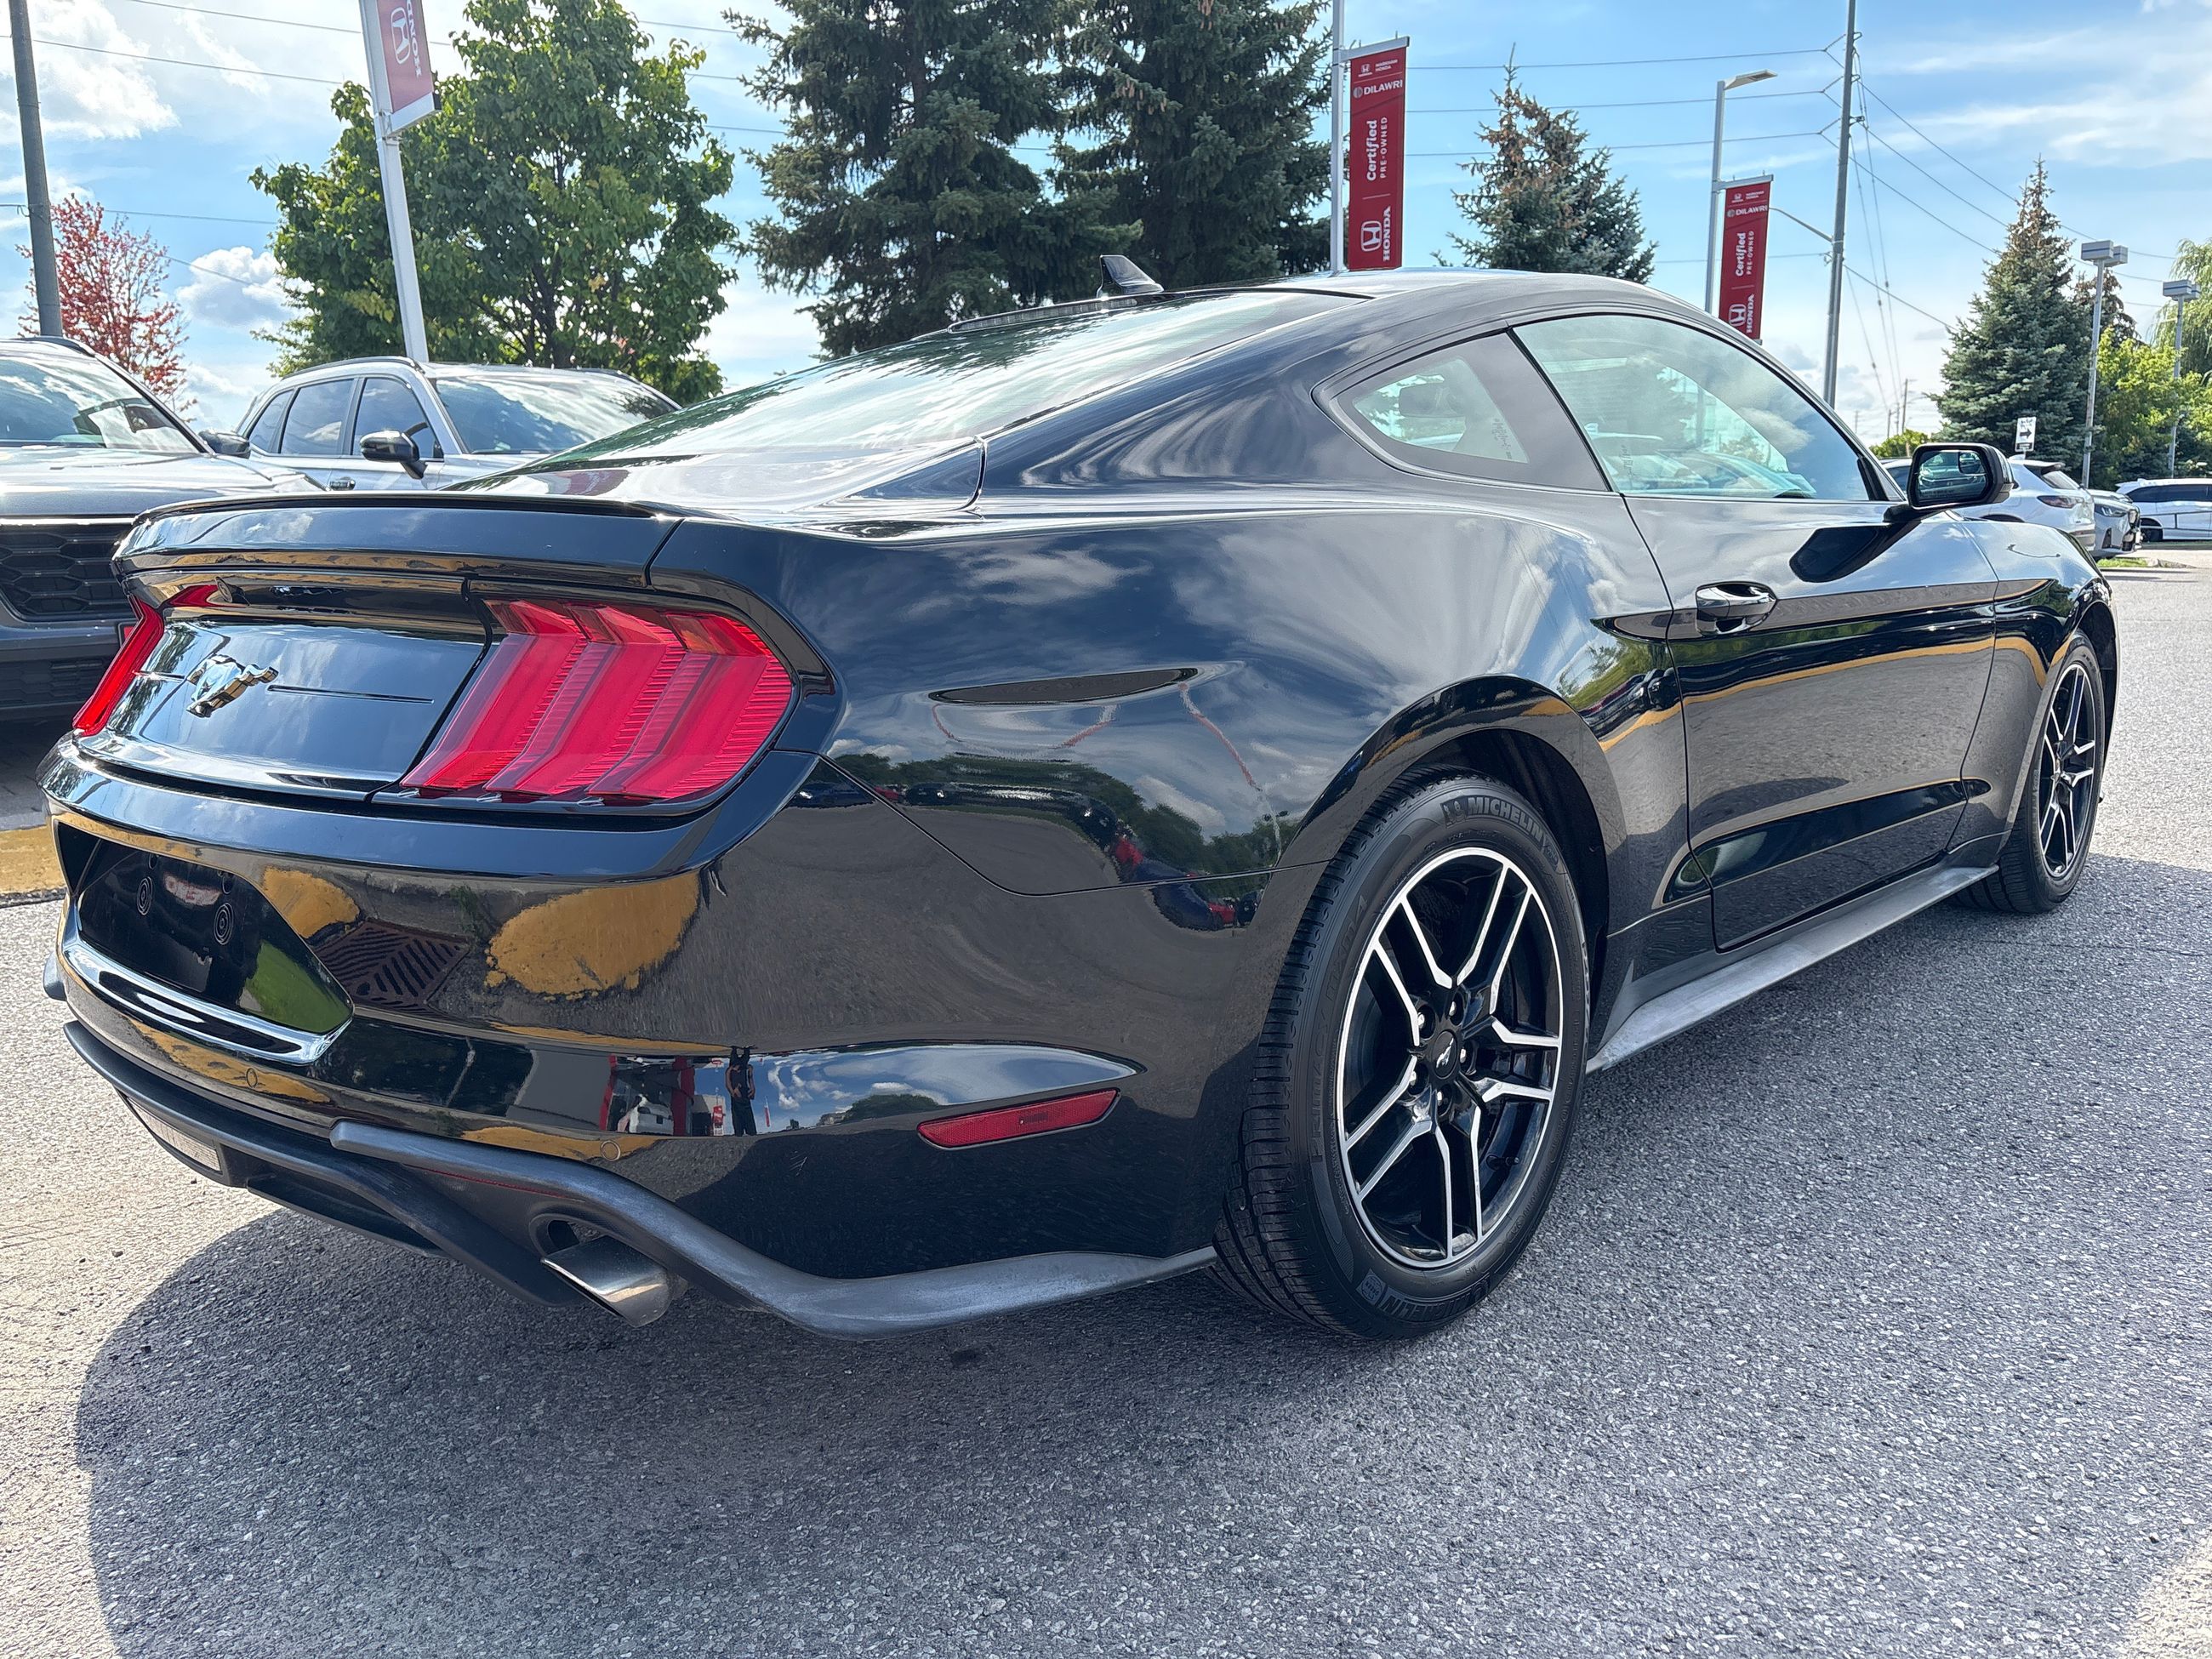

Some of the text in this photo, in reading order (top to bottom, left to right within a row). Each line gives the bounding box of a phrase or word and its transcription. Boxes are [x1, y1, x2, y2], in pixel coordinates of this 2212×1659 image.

[407, 0, 422, 77] HOND
[1363, 79, 1403, 95] DILAWRI
[1366, 120, 1379, 181] Certified
[1382, 206, 1391, 261] HONDA
[1736, 205, 1768, 216] DILAWRI
[1736, 232, 1747, 276] Certified
[1746, 294, 1755, 333] HONDA
[1468, 796, 1546, 845] MICHELIN
